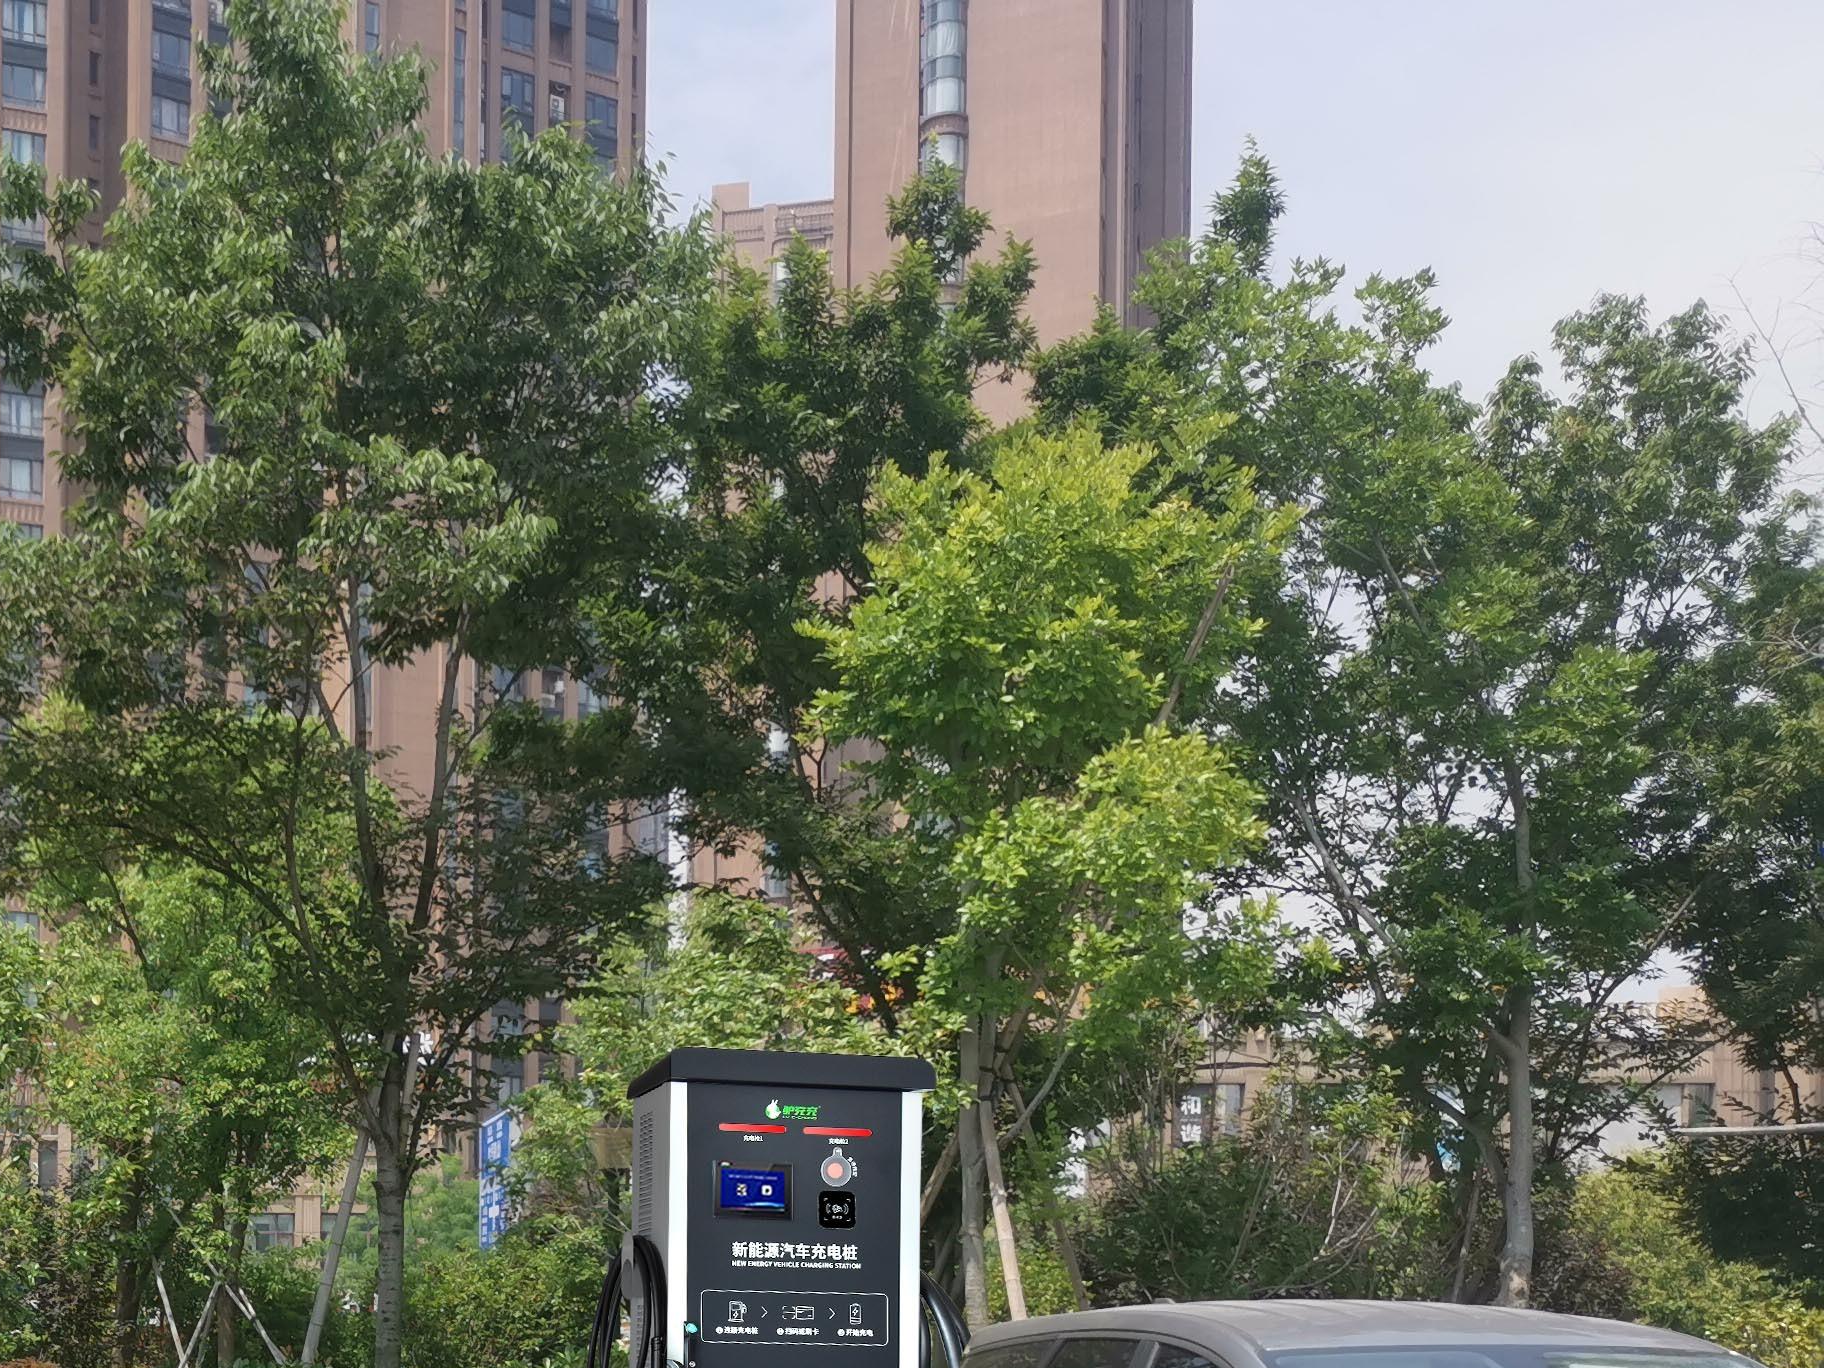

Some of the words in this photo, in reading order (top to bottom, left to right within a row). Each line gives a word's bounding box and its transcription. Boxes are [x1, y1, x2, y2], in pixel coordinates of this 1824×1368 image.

[731, 1241, 859, 1261] 新能源汽车充电桩
[748, 1260, 773, 1268] ENERGY
[801, 1261, 834, 1269] CHARGING
[834, 1262, 862, 1270] STATION
